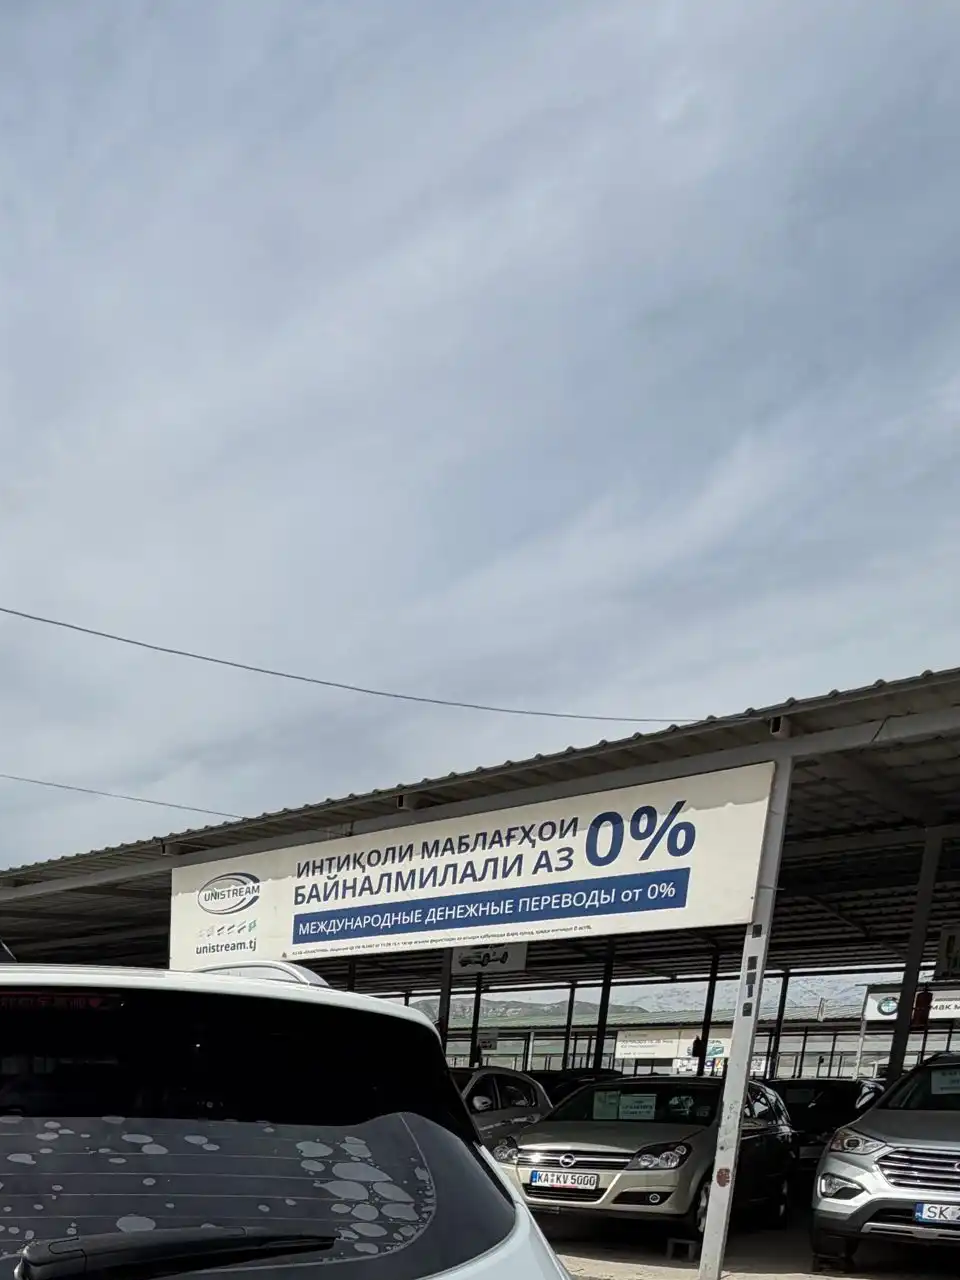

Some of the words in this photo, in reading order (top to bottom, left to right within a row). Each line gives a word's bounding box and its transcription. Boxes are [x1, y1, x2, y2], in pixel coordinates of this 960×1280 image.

[296, 843, 414, 879] ИНТИҚОЛИ
[421, 816, 579, 860] МАБЛАҒҲОИ
[585, 799, 697, 868] 0%
[204, 885, 260, 902] UNISTREAM
[293, 853, 524, 906] БАЙНАЛМИЛАЛИ
[531, 847, 574, 875] АЗ
[298, 910, 422, 936] МЕЖДУНАРОДНЫЕ
[424, 900, 514, 925] ДЕНЕЖНЫЕ
[518, 889, 616, 913] ПЕРЕВОДЫ
[621, 888, 642, 903] от
[647, 882, 676, 900] 0%
[195, 938, 257, 955] unistream.tj
[537, 1171, 549, 1183] KA
[555, 1173, 569, 1185] KV
[927, 1205, 950, 1220] SK
